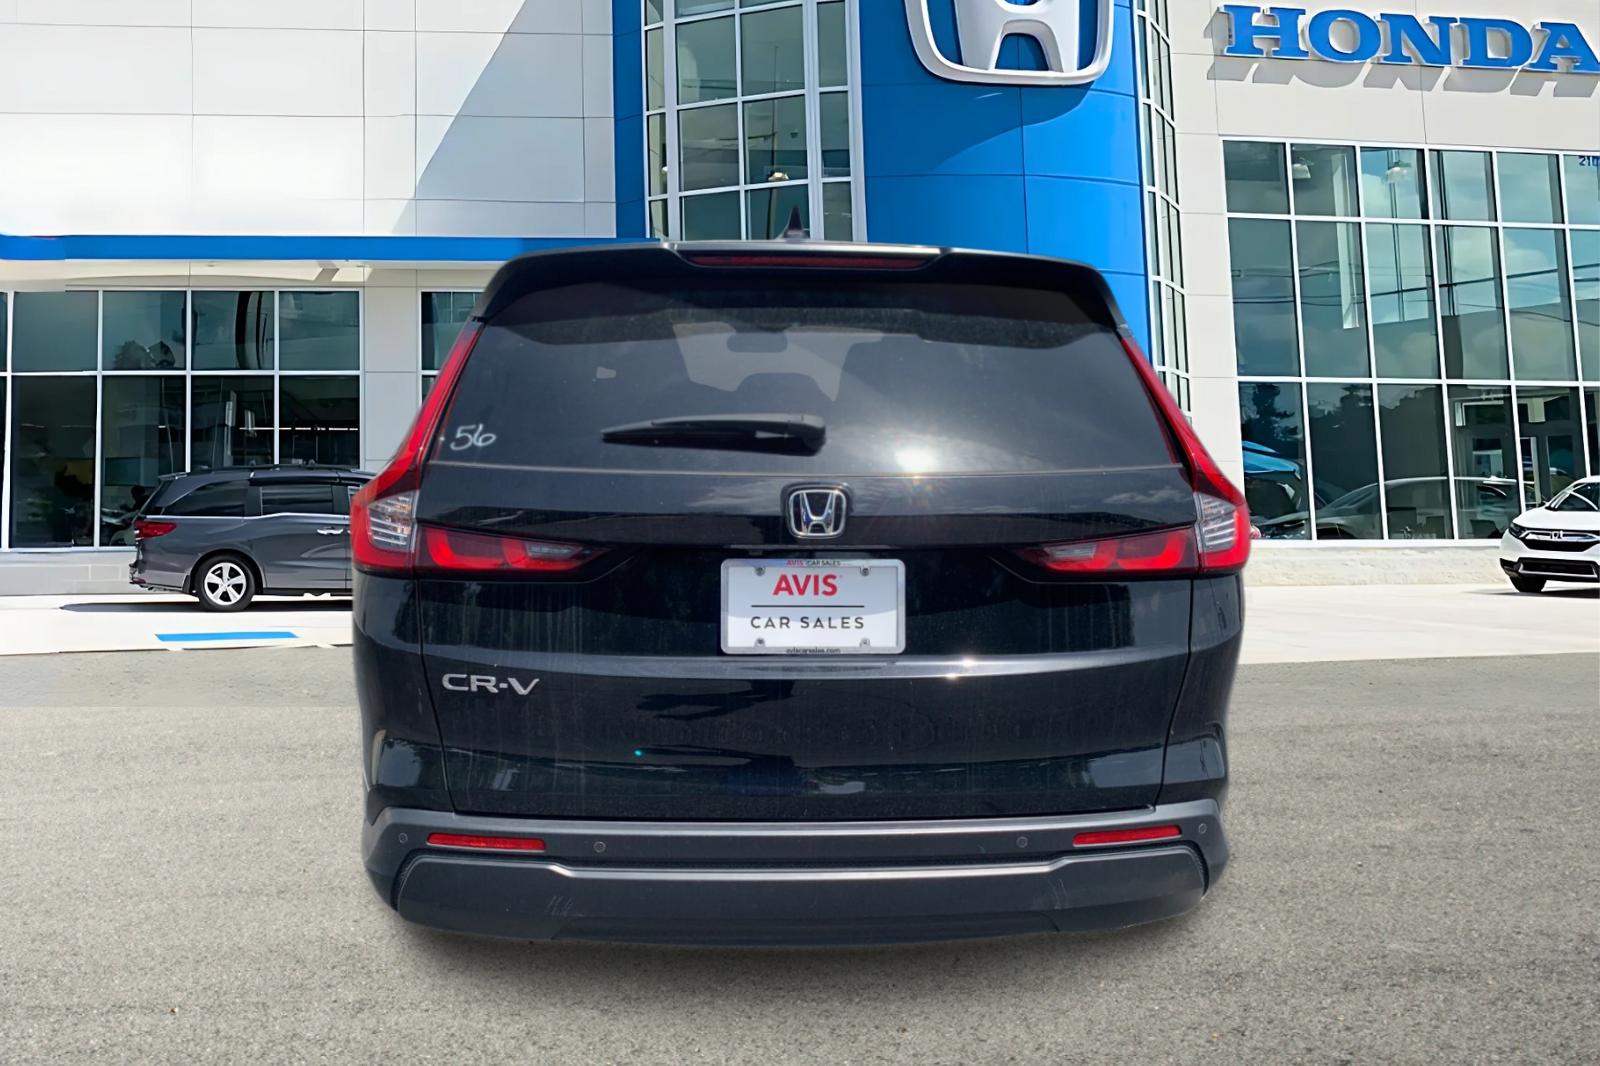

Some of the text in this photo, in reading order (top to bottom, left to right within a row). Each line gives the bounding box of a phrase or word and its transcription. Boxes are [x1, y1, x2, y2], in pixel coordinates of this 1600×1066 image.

[1221, 4, 1600, 73] HONDA
[450, 423, 497, 451] 56
[786, 559, 804, 567] AVIS
[772, 574, 838, 597] AVIS
[750, 616, 865, 630] CAR SALES
[442, 673, 540, 695] CR-V
